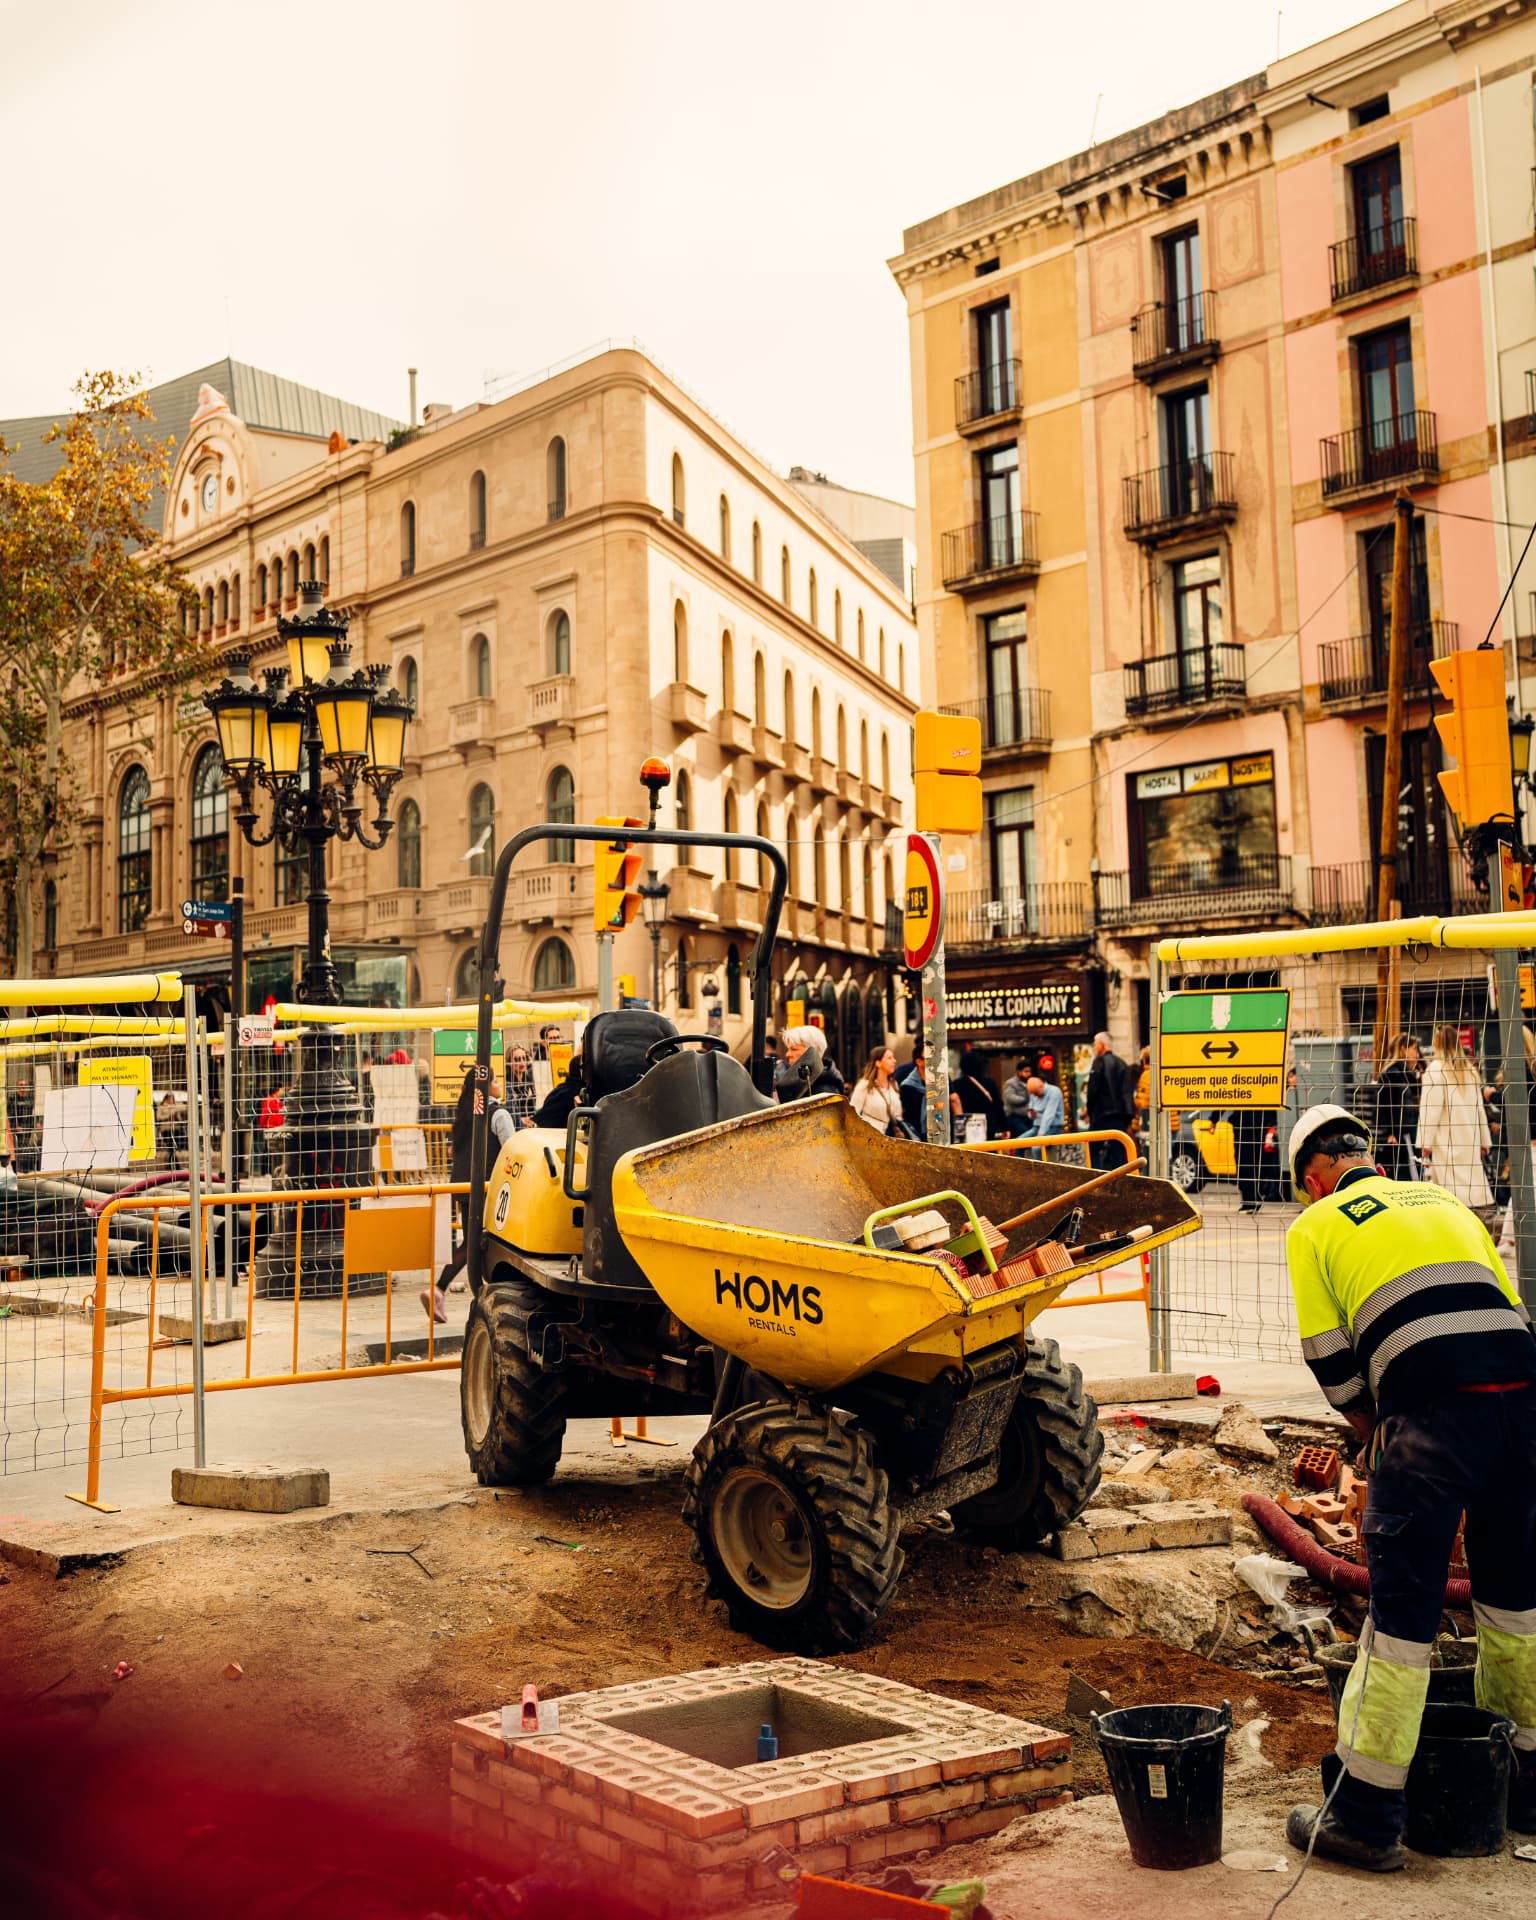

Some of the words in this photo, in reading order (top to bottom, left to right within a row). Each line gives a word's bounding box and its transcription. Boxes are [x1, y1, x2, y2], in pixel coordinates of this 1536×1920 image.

[1145, 776, 1177, 789] HOSTAL
[1193, 768, 1218, 781] MARE
[995, 997, 1005, 1016] &
[1006, 994, 1069, 1016] COMPANY
[1164, 1074, 1206, 1088] Preguem
[1209, 1075, 1228, 1088] que
[1231, 1073, 1279, 1087] disculpin
[1186, 1088, 1200, 1100] les
[1203, 1087, 1252, 1100] molèsties
[495, 1189, 509, 1223] 20
[748, 1317, 796, 1337] RENTALS
